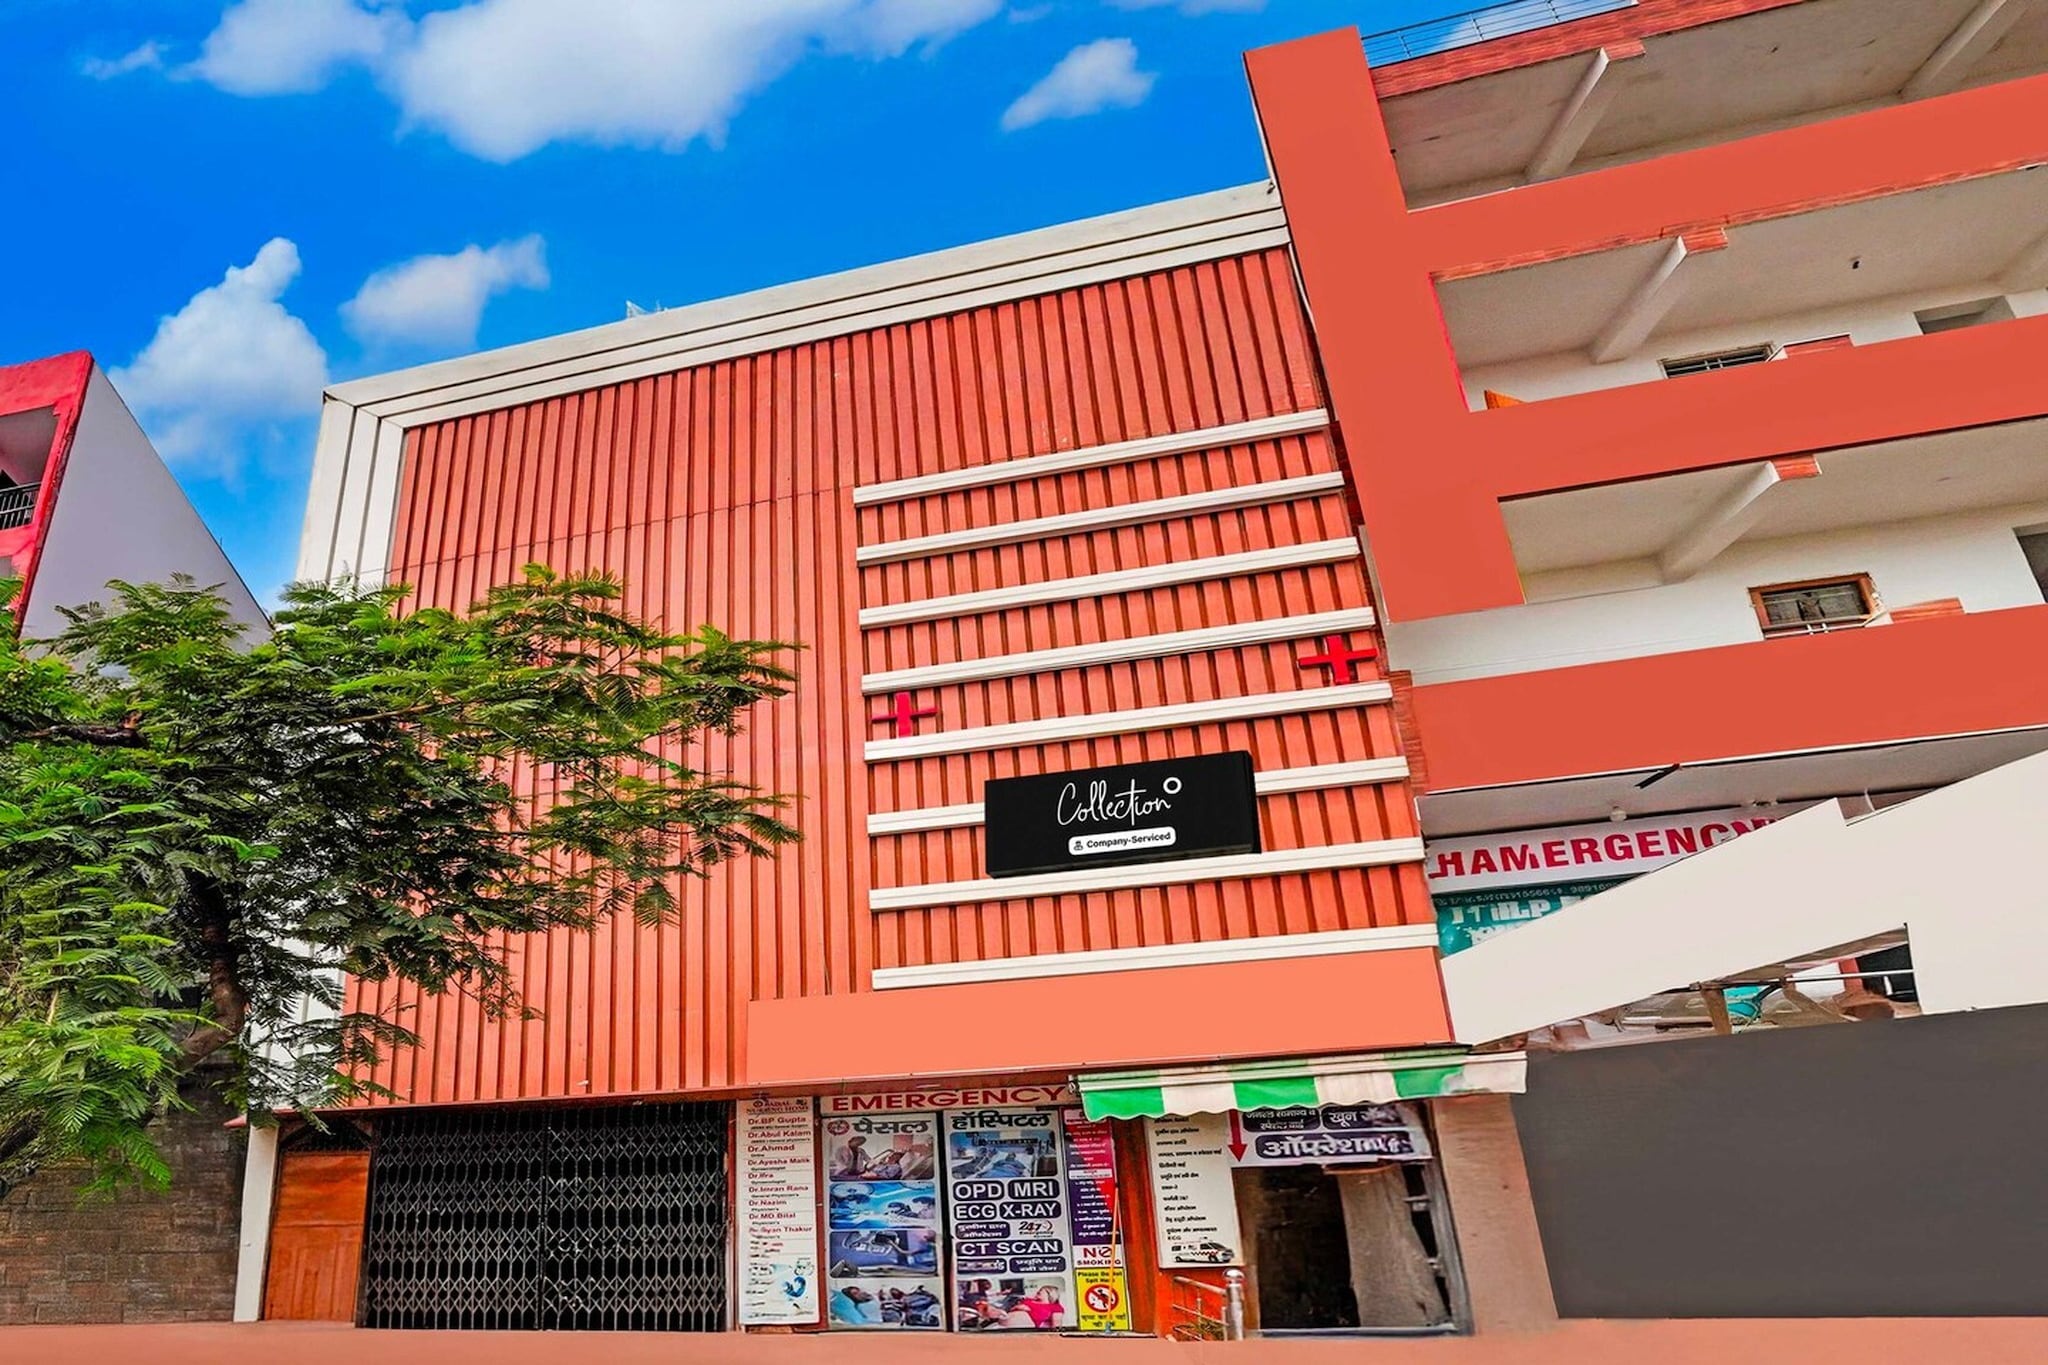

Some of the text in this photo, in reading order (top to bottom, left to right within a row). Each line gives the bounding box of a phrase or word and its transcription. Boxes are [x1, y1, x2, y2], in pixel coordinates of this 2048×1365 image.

[1057, 778, 1171, 826] Collection
[1086, 832, 1171, 849] Company-Serviced
[833, 1086, 1066, 1111] EMERGENCY
[951, 1111, 1052, 1130] हॉस्पिटल
[955, 1181, 1053, 1199] OPD MRI
[956, 1203, 1056, 1219] ECG X-RAY
[961, 1241, 1059, 1255] CT SCAN
